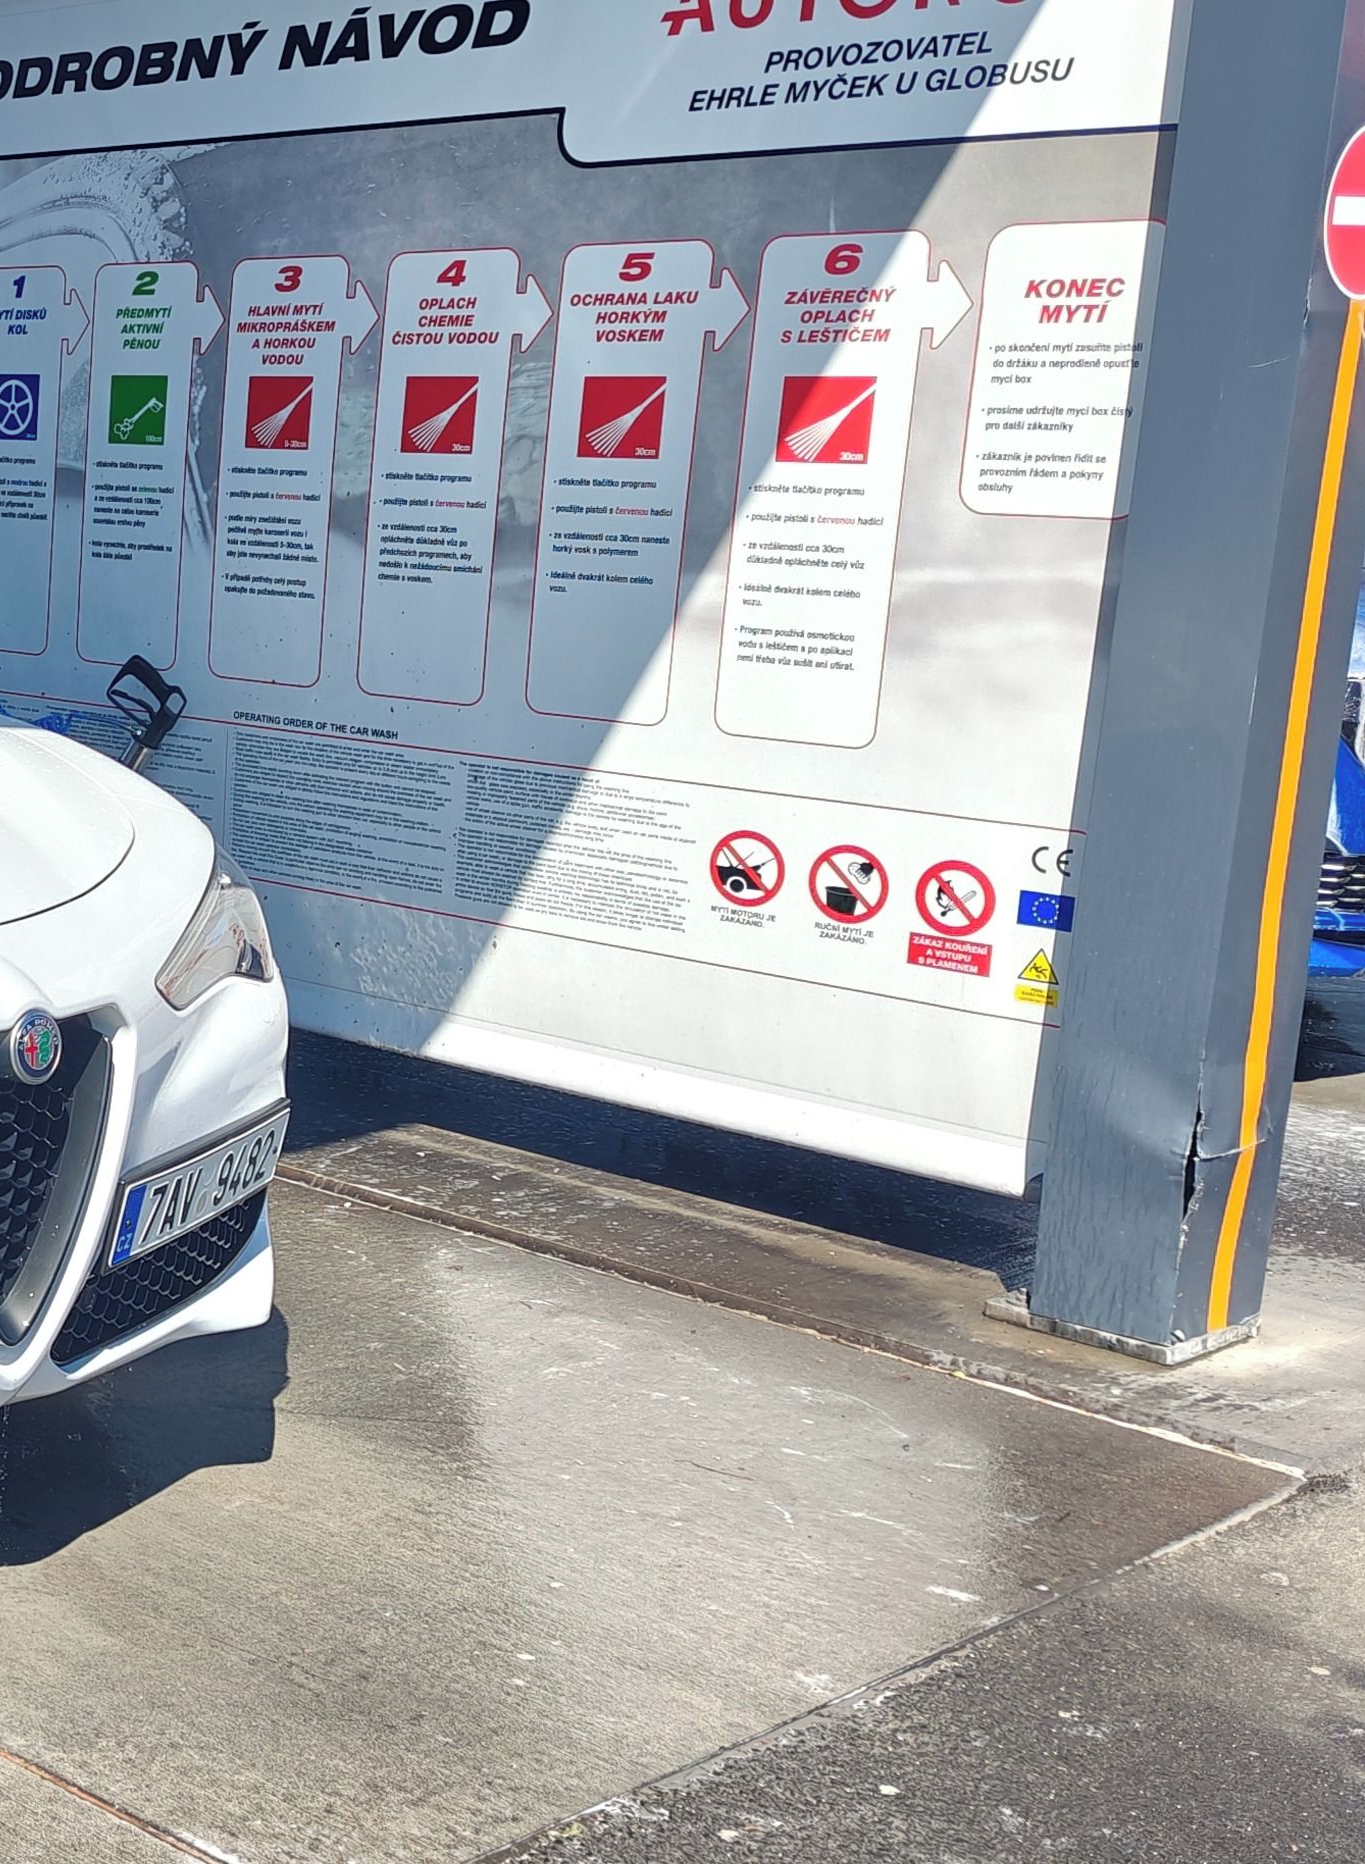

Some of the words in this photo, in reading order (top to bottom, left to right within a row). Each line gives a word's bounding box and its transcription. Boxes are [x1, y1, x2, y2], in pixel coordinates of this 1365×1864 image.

[277, 0, 531, 70] NÁVOD
[764, 31, 992, 73] PROVOZOVATEL
[688, 83, 779, 112] EHRLE
[784, 73, 889, 104] MYČEK
[895, 70, 919, 94] U
[925, 57, 1075, 91] GLOBUSU
[824, 243, 864, 275] 6
[436, 259, 467, 287] 4
[619, 252, 655, 282] 5
[132, 271, 159, 296] 2
[274, 265, 303, 292] 3
[12, 275, 26, 299] 1
[1024, 278, 1126, 298] KONEC
[570, 292, 648, 306] OCHRANA
[653, 290, 699, 305] LAKU
[784, 286, 897, 304] ZÁVĚREČNÝ
[248, 302, 292, 316] HLAVNÍ
[292, 302, 325, 316] MYTÍ
[419, 297, 477, 310] OPLACH
[15, 307, 47, 321] DISKŮ
[116, 305, 172, 319] PŘEDMYTÍ
[595, 308, 668, 324] HORKÝM
[800, 309, 876, 324] OPLACH
[1038, 300, 1111, 323] MYTÍ
[120, 321, 165, 334] AKTIVNÍ
[236, 319, 336, 333] MIKROPRÁŠKEM
[418, 314, 475, 327] CHEMIE
[7, 324, 28, 336] KOL
[596, 329, 664, 342] VOSKEM
[780, 330, 792, 343] S
[796, 327, 891, 343] LEŠTIČEM
[122, 337, 162, 350] PĚNOU
[251, 338, 260, 349] A
[263, 337, 316, 349] HORKOU
[391, 331, 444, 345] ČISTOU
[448, 331, 500, 344] VODOU
[994, 345, 1006, 354] po
[1008, 342, 1051, 352] skončení
[1052, 343, 1073, 353] mytí
[261, 354, 304, 365] VODOU
[992, 359, 1005, 368] do
[1006, 359, 1038, 368] držáku
[1049, 359, 1101, 370] neprodleně
[991, 374, 1013, 385] mycí
[1014, 374, 1032, 384] box
[987, 406, 1024, 416] prosíme
[1026, 406, 1064, 417] udržujte
[1066, 406, 1090, 417] mycí
[1091, 406, 1109, 416] box
[985, 423, 1001, 431] pro
[1002, 421, 1025, 430] další
[1026, 421, 1073, 432] zákazníky
[451, 443, 470, 452] 30cm
[635, 447, 656, 456] 30cm
[839, 451, 864, 461] 30cm
[981, 453, 1021, 462] zákazník
[1023, 454, 1033, 463] je
[1035, 454, 1072, 464] povinen
[1095, 455, 1106, 463] se
[979, 468, 1027, 478] provozním
[1029, 468, 1058, 478] řádem
[1069, 470, 1104, 480] pokyny
[558, 478, 590, 487] stiskněte
[592, 479, 619, 488] tlačítko
[620, 480, 656, 489] programu
[753, 483, 790, 493] stiskněte
[792, 485, 822, 495] tlačítko
[824, 487, 865, 497] programu
[978, 483, 1013, 493] obsluhy
[555, 505, 584, 514] použijte
[650, 508, 673, 517] hadicí
[619, 534, 640, 543] 30cm
[552, 544, 572, 554] horký
[574, 546, 591, 554] vosk
[598, 547, 638, 557] polymerem
[577, 572, 605, 581] dvakrát
[606, 574, 628, 583] kolem
[629, 575, 654, 584] celého
[233, 711, 281, 725] OPERATING
[283, 717, 313, 729] ORDER
[315, 721, 328, 731] OF
[330, 723, 347, 733] THE
[349, 725, 369, 736] CAR
[371, 728, 398, 740] WASH
[710, 905, 729, 914] MYTÍ
[730, 908, 765, 920] MOTORU
[766, 914, 776, 922] JE
[842, 926, 862, 936] MYTÍ
[863, 930, 874, 938] JE
[912, 935, 944, 948] ZÁKAZ
[944, 941, 988, 955] KOUŘENÍ
[925, 948, 933, 956] A
[935, 950, 972, 963] VSTUPU
[918, 956, 925, 964] S
[926, 957, 978, 973] PLAMENEM
[138, 1166, 203, 1244] 7AV
[212, 1128, 276, 1207] 9482
[116, 1233, 132, 1252] CZ
